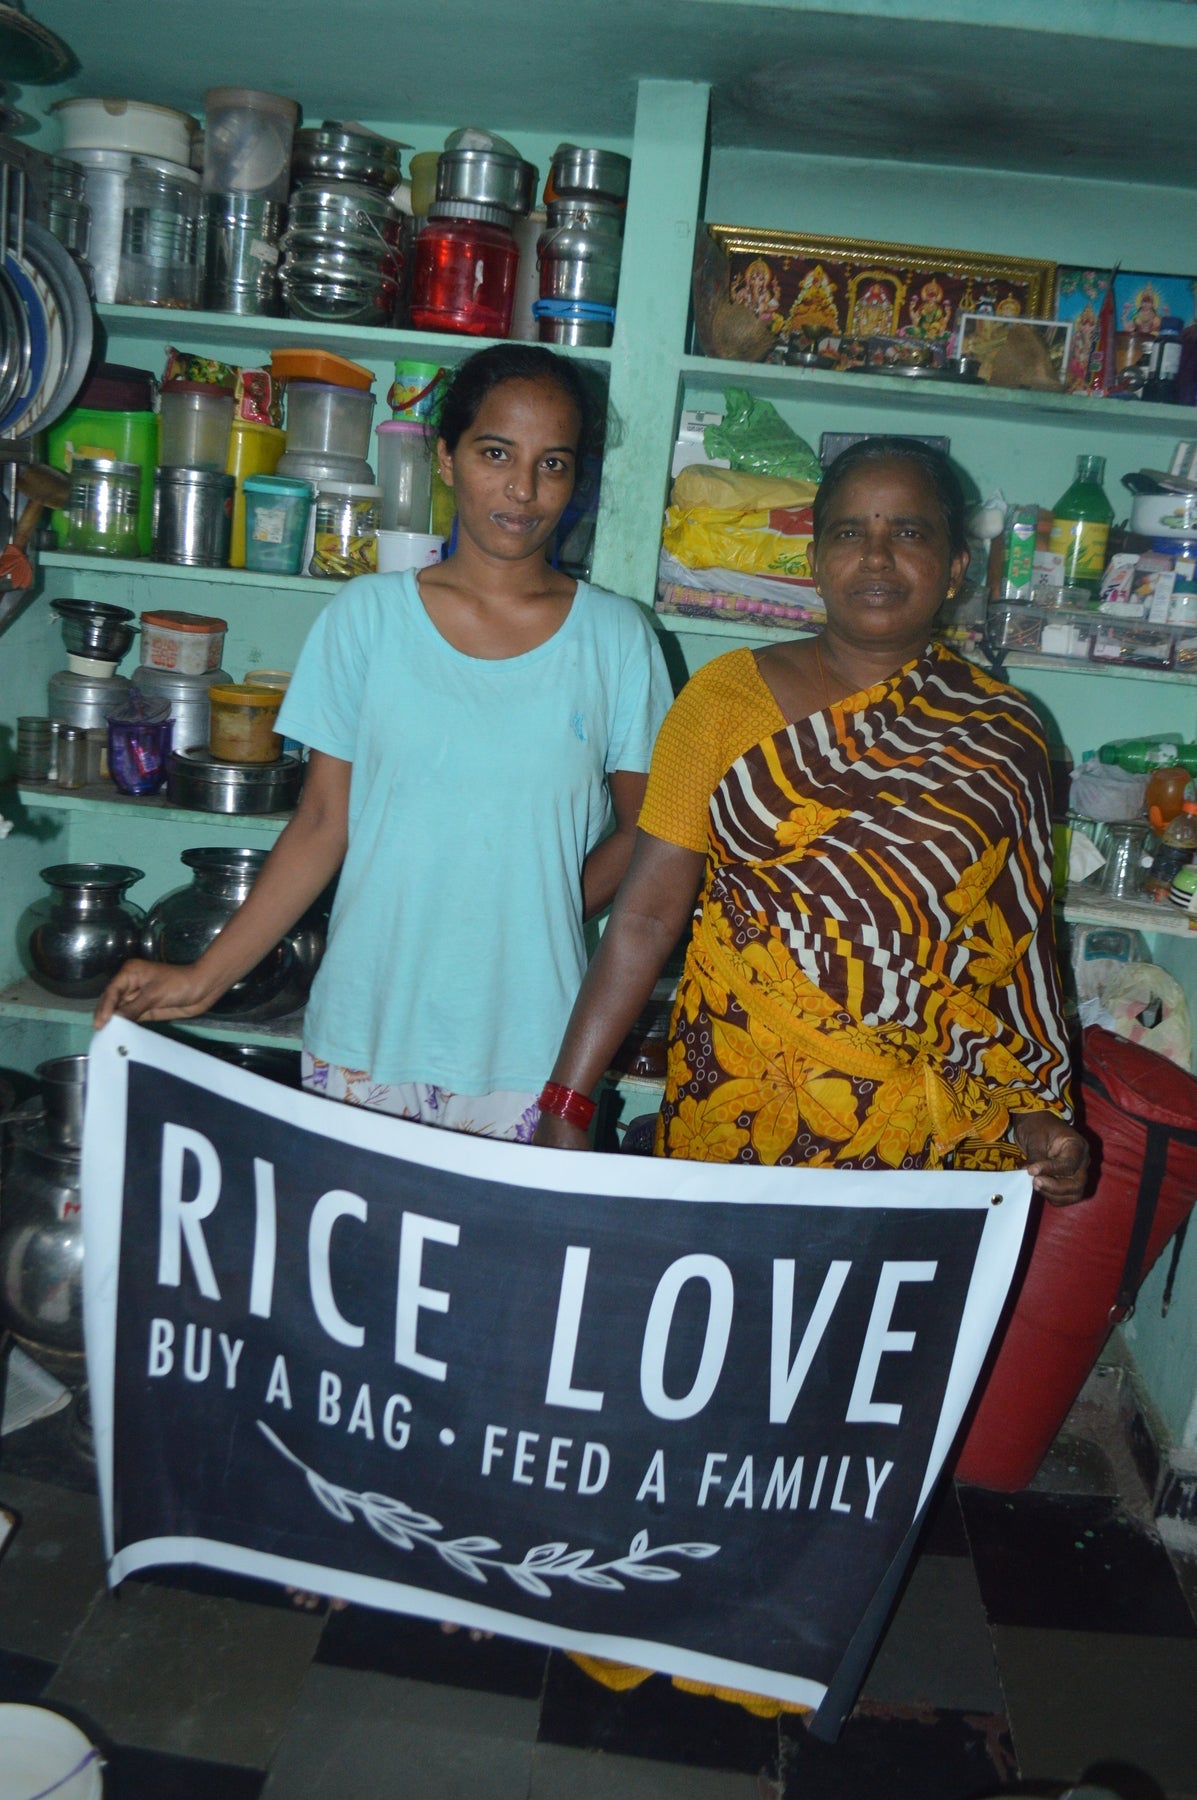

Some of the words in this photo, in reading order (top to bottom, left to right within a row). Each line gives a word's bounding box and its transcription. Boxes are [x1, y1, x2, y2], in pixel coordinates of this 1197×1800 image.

[157, 1122, 462, 1382] RICE
[544, 1245, 939, 1425] LOVE
[148, 1317, 245, 1389] BUY
[265, 1355, 292, 1410] A
[318, 1370, 412, 1451] BAG
[481, 1425, 611, 1496] FEED
[635, 1449, 667, 1503] A
[697, 1452, 895, 1520] FAMILY
